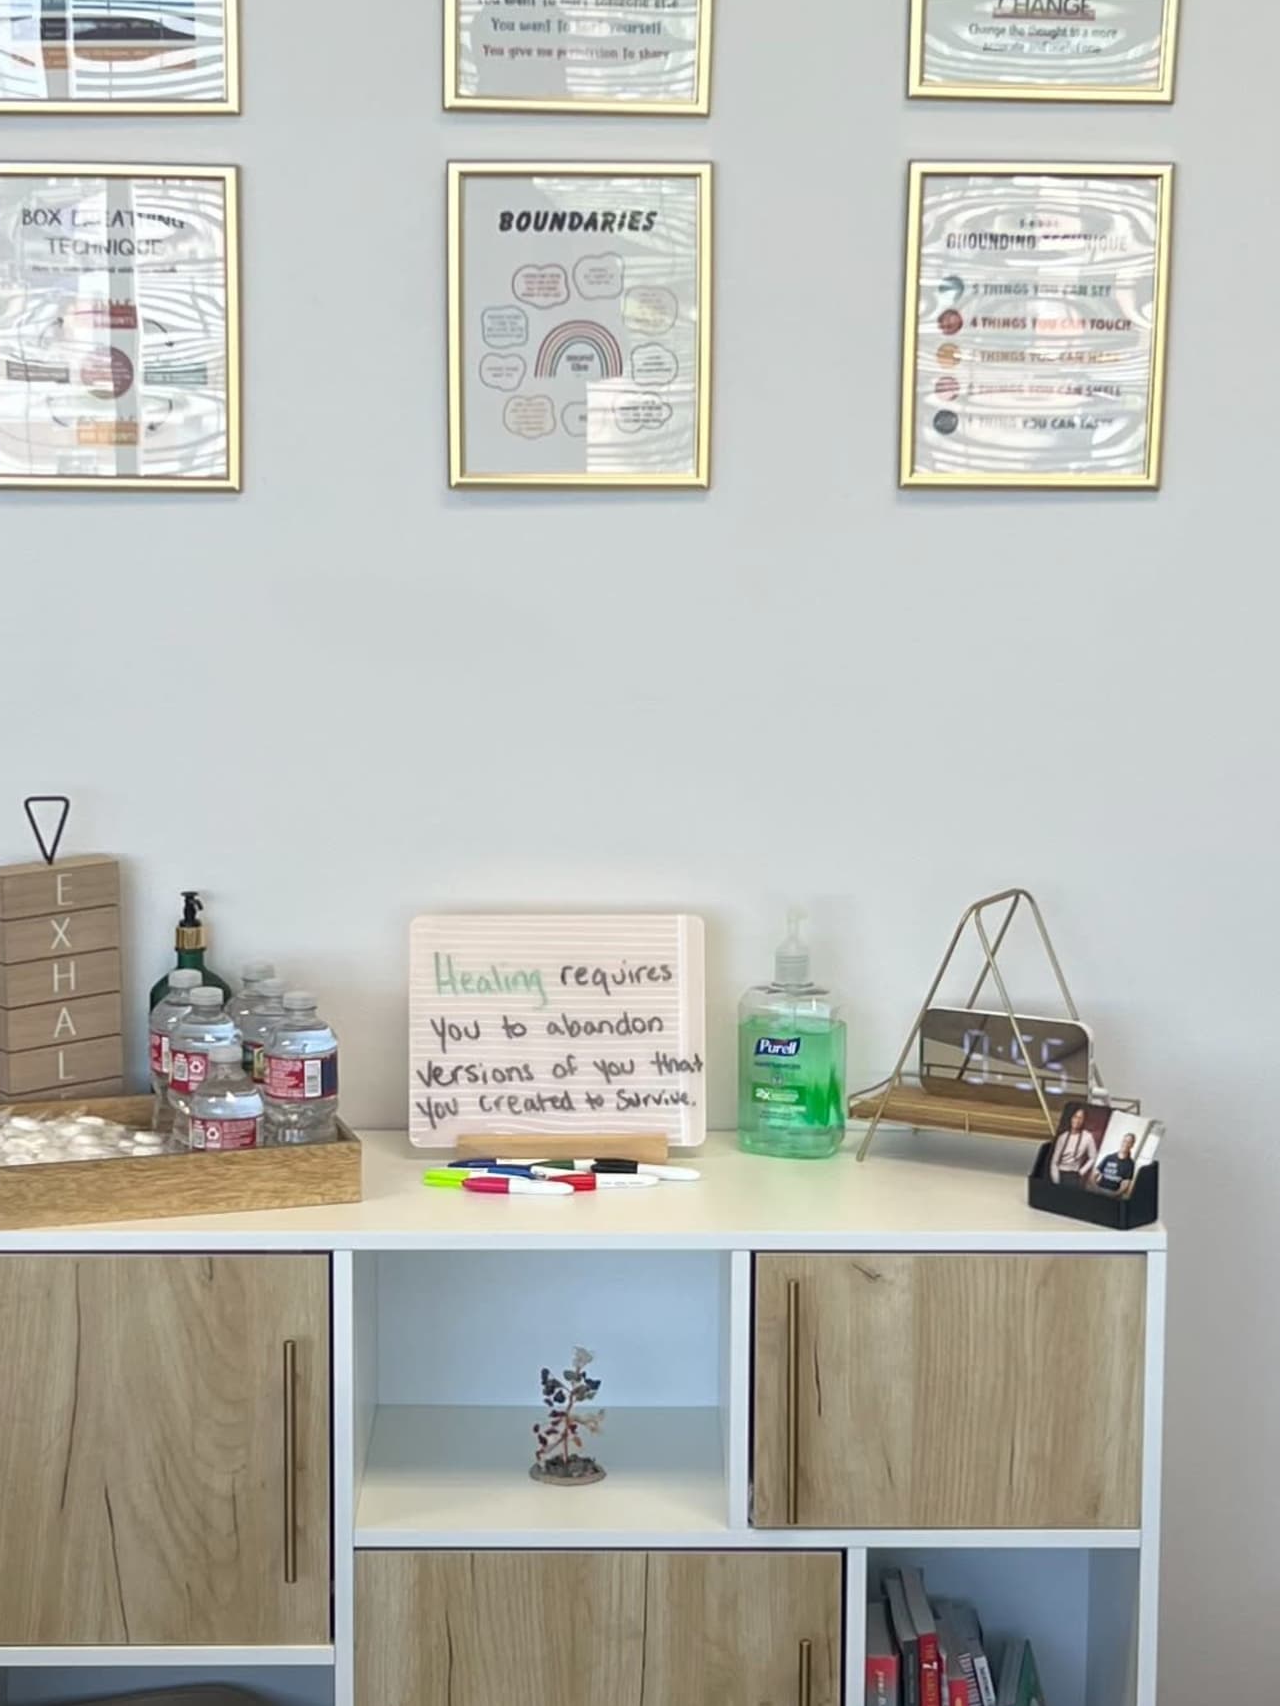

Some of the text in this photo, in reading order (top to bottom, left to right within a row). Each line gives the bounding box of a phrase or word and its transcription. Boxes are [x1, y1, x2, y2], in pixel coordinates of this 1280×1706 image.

[491, 17, 515, 33] You
[520, 18, 551, 33] want
[483, 44, 504, 57] You
[508, 45, 533, 60] give
[623, 47, 635, 59] to
[22, 208, 62, 227] BOX
[499, 211, 658, 234] BOUNDARIES
[982, 284, 1028, 296] THINGS
[970, 317, 978, 329] 4
[982, 317, 1027, 329] THINGS
[980, 352, 1026, 363] THINGS
[1051, 418, 1076, 430] CAN
[433, 951, 673, 1010] Healing requires
[502, 1015, 528, 1039] to
[547, 1012, 665, 1039] abandon
[551, 1055, 579, 1079] of
[593, 1061, 635, 1084] you
[650, 1051, 705, 1077] that
[478, 1090, 575, 1115] created
[585, 1092, 604, 1110] to
[922, 1661, 938, 1670] 7
